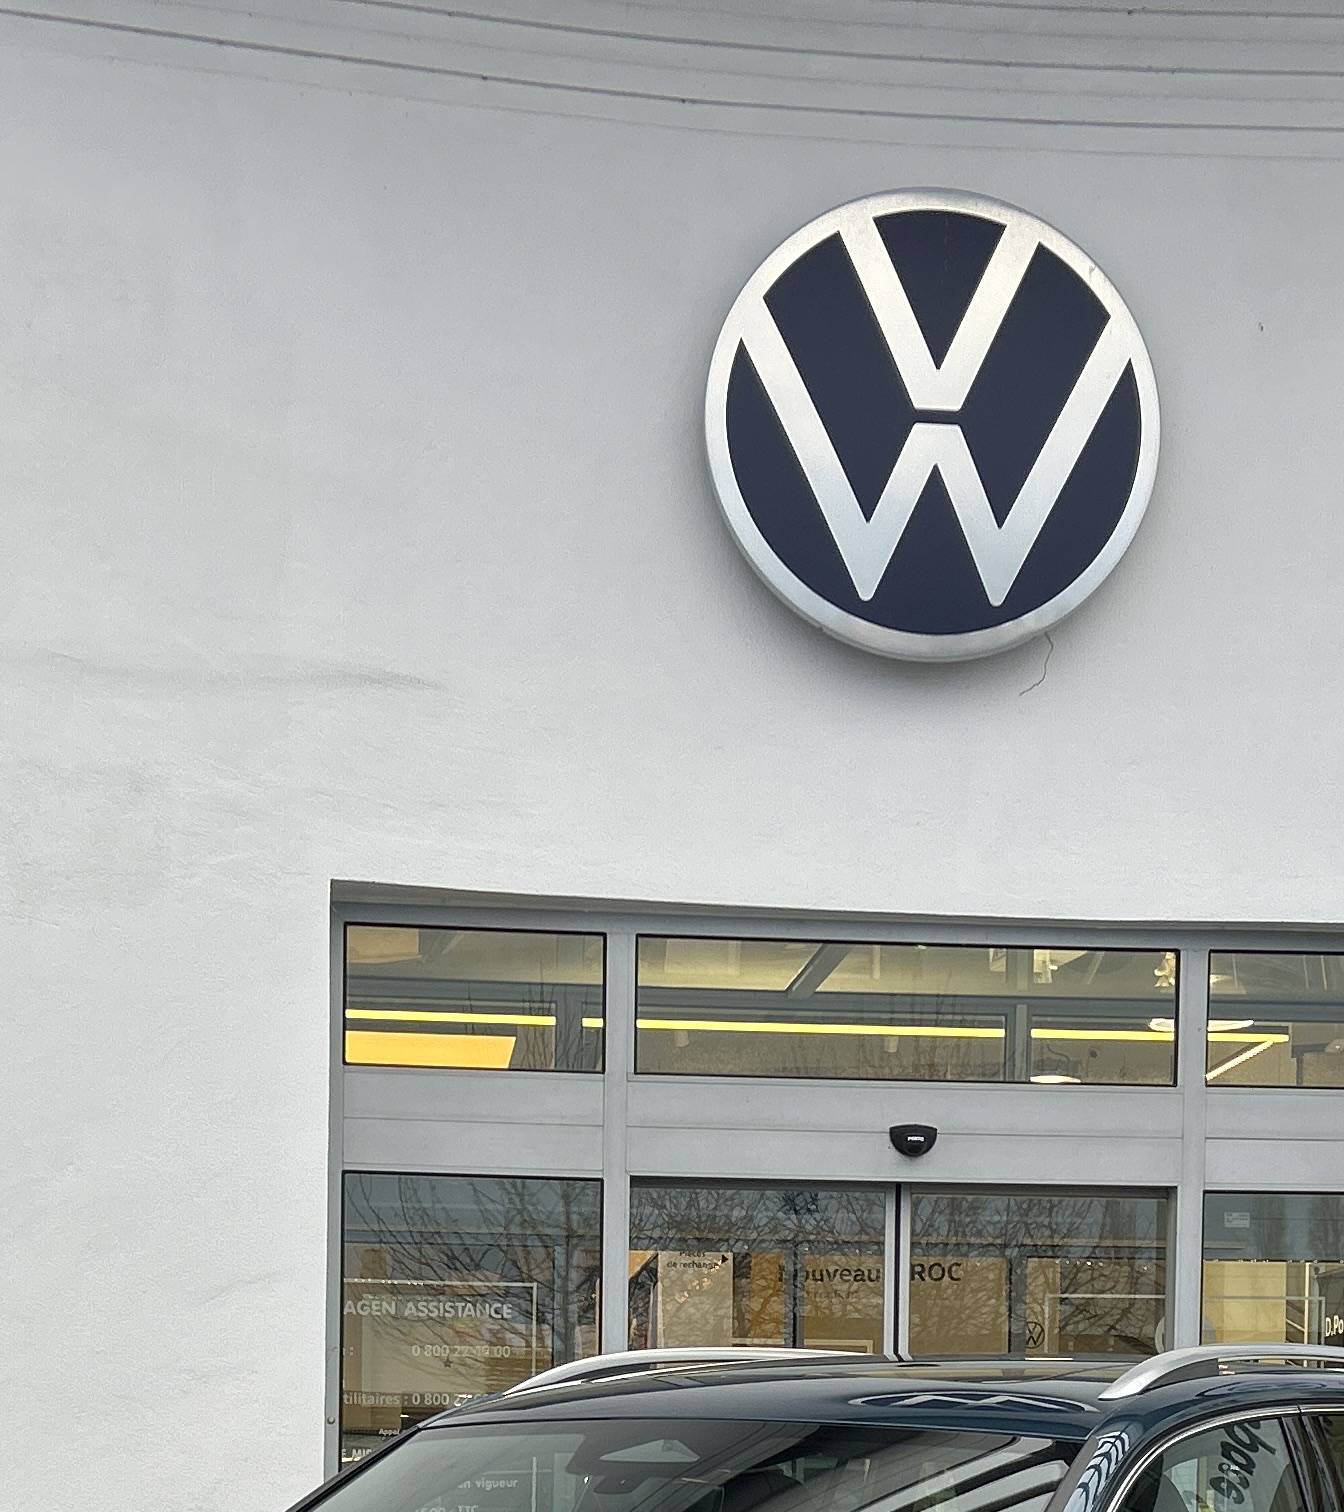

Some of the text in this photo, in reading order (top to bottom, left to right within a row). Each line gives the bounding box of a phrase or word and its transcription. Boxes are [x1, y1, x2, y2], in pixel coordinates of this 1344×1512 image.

[708, 192, 1158, 655] VW
[405, 1301, 513, 1319] ASSISTANCE
[475, 1478, 518, 1491] vigueur
